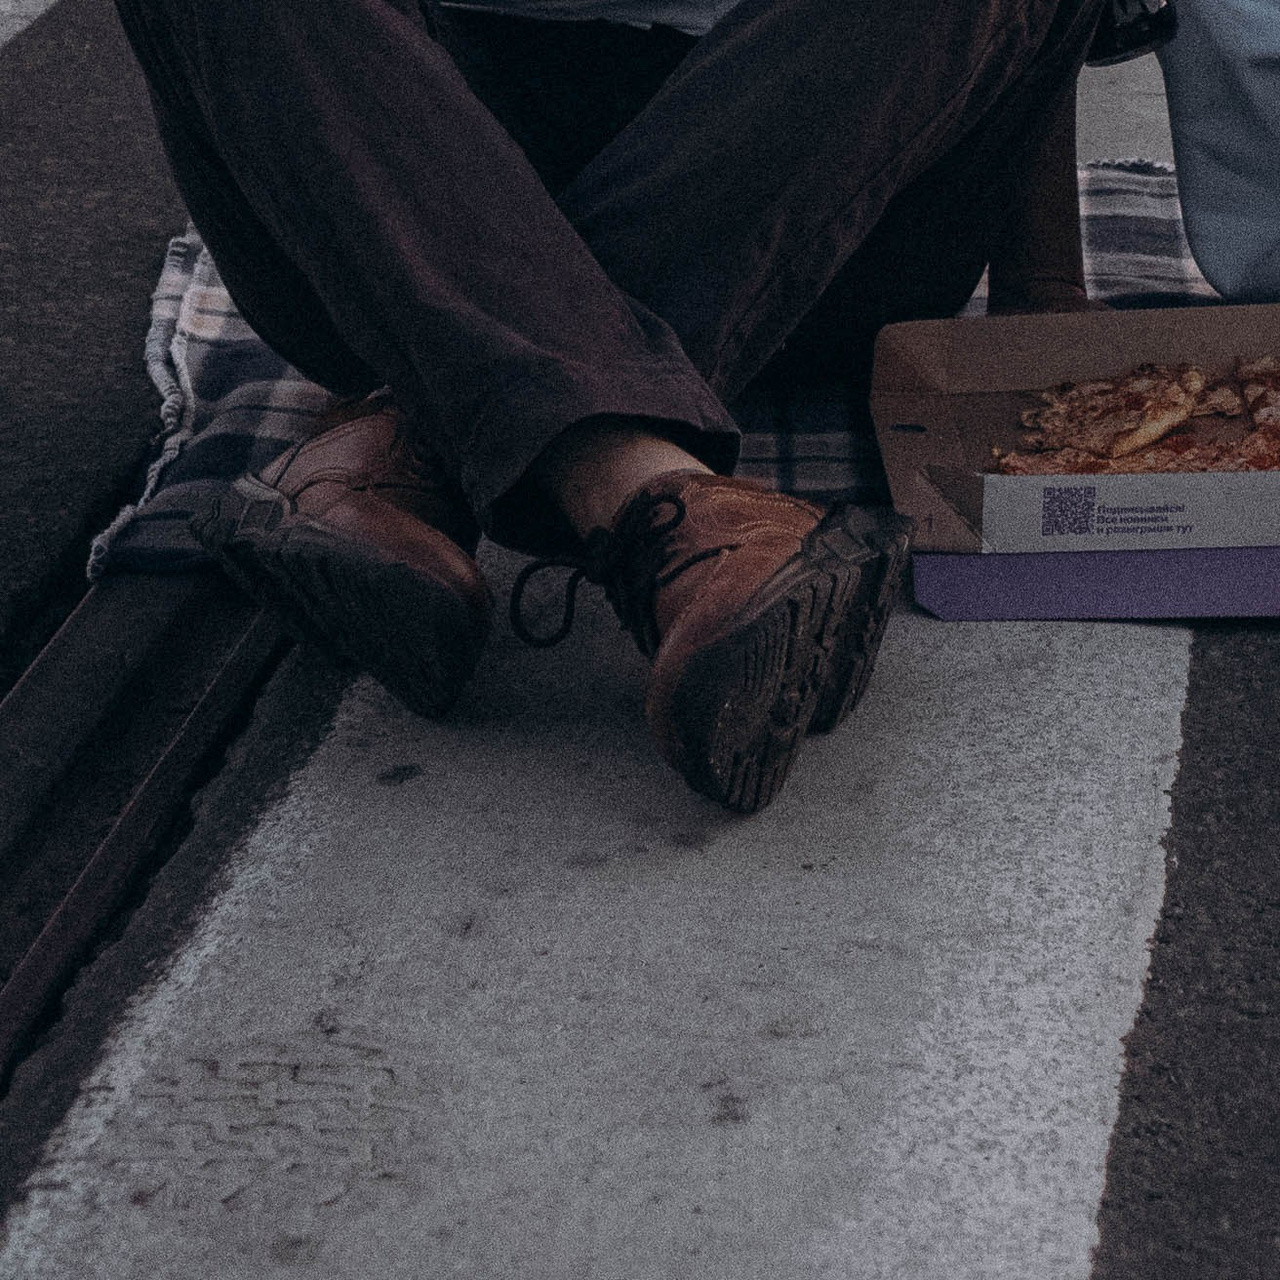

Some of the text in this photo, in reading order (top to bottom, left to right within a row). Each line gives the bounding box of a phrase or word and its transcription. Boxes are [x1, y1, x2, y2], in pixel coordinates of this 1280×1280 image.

[1097, 515, 1168, 524] Все новинки
[1176, 525, 1193, 534] тут
